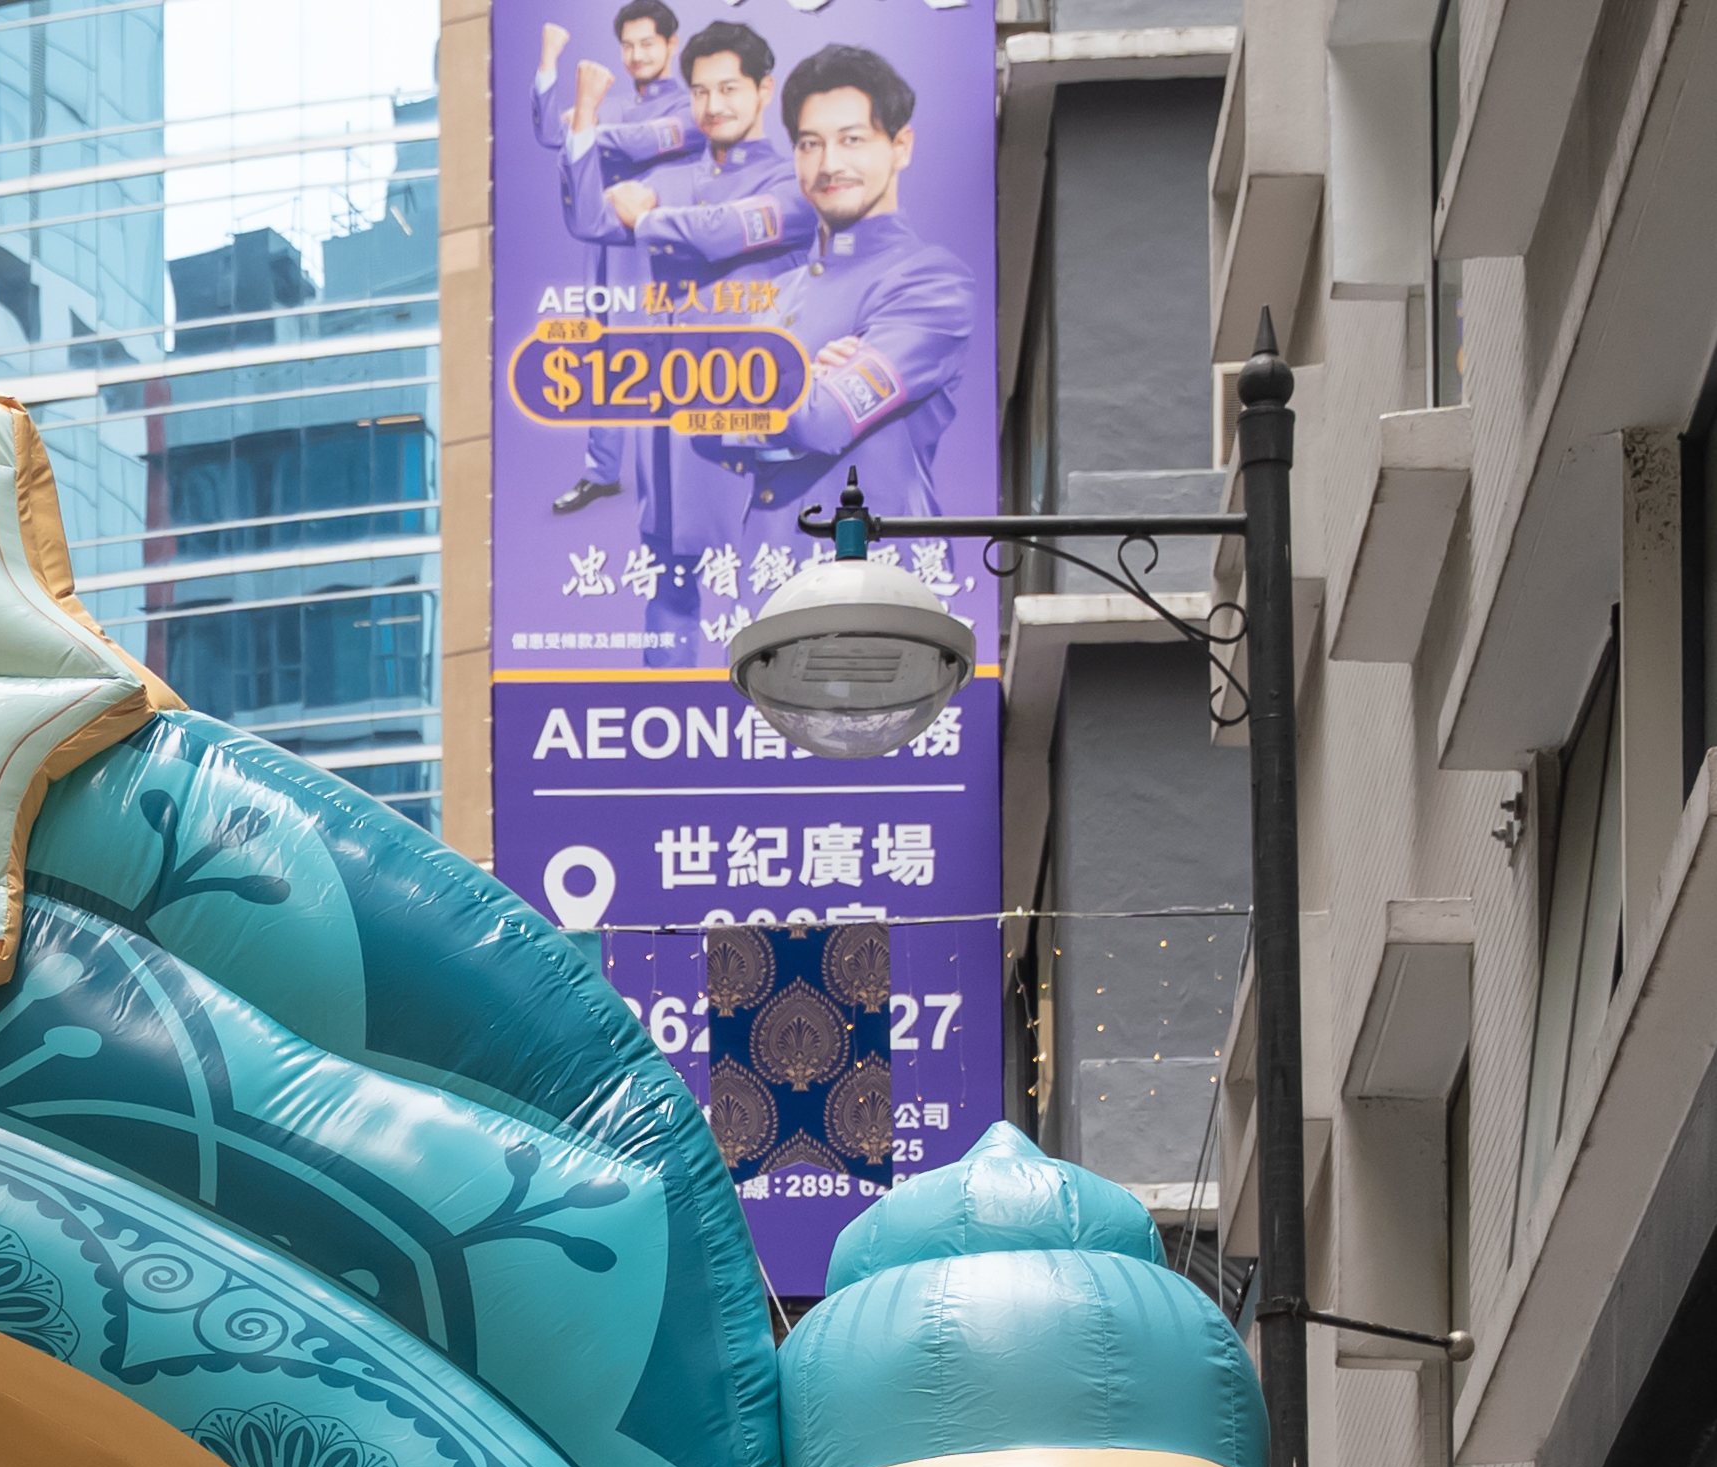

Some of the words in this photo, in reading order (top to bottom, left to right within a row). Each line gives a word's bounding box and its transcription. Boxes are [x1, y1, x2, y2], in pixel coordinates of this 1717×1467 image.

[537, 286, 636, 313] AEON
[642, 281, 779, 314] 私人貸款
[547, 321, 589, 340] 高達
[542, 346, 778, 412] $12,000
[688, 411, 771, 431] 現金回贈
[533, 704, 961, 760] AEON信務
[654, 823, 935, 889] 世紀廣場
